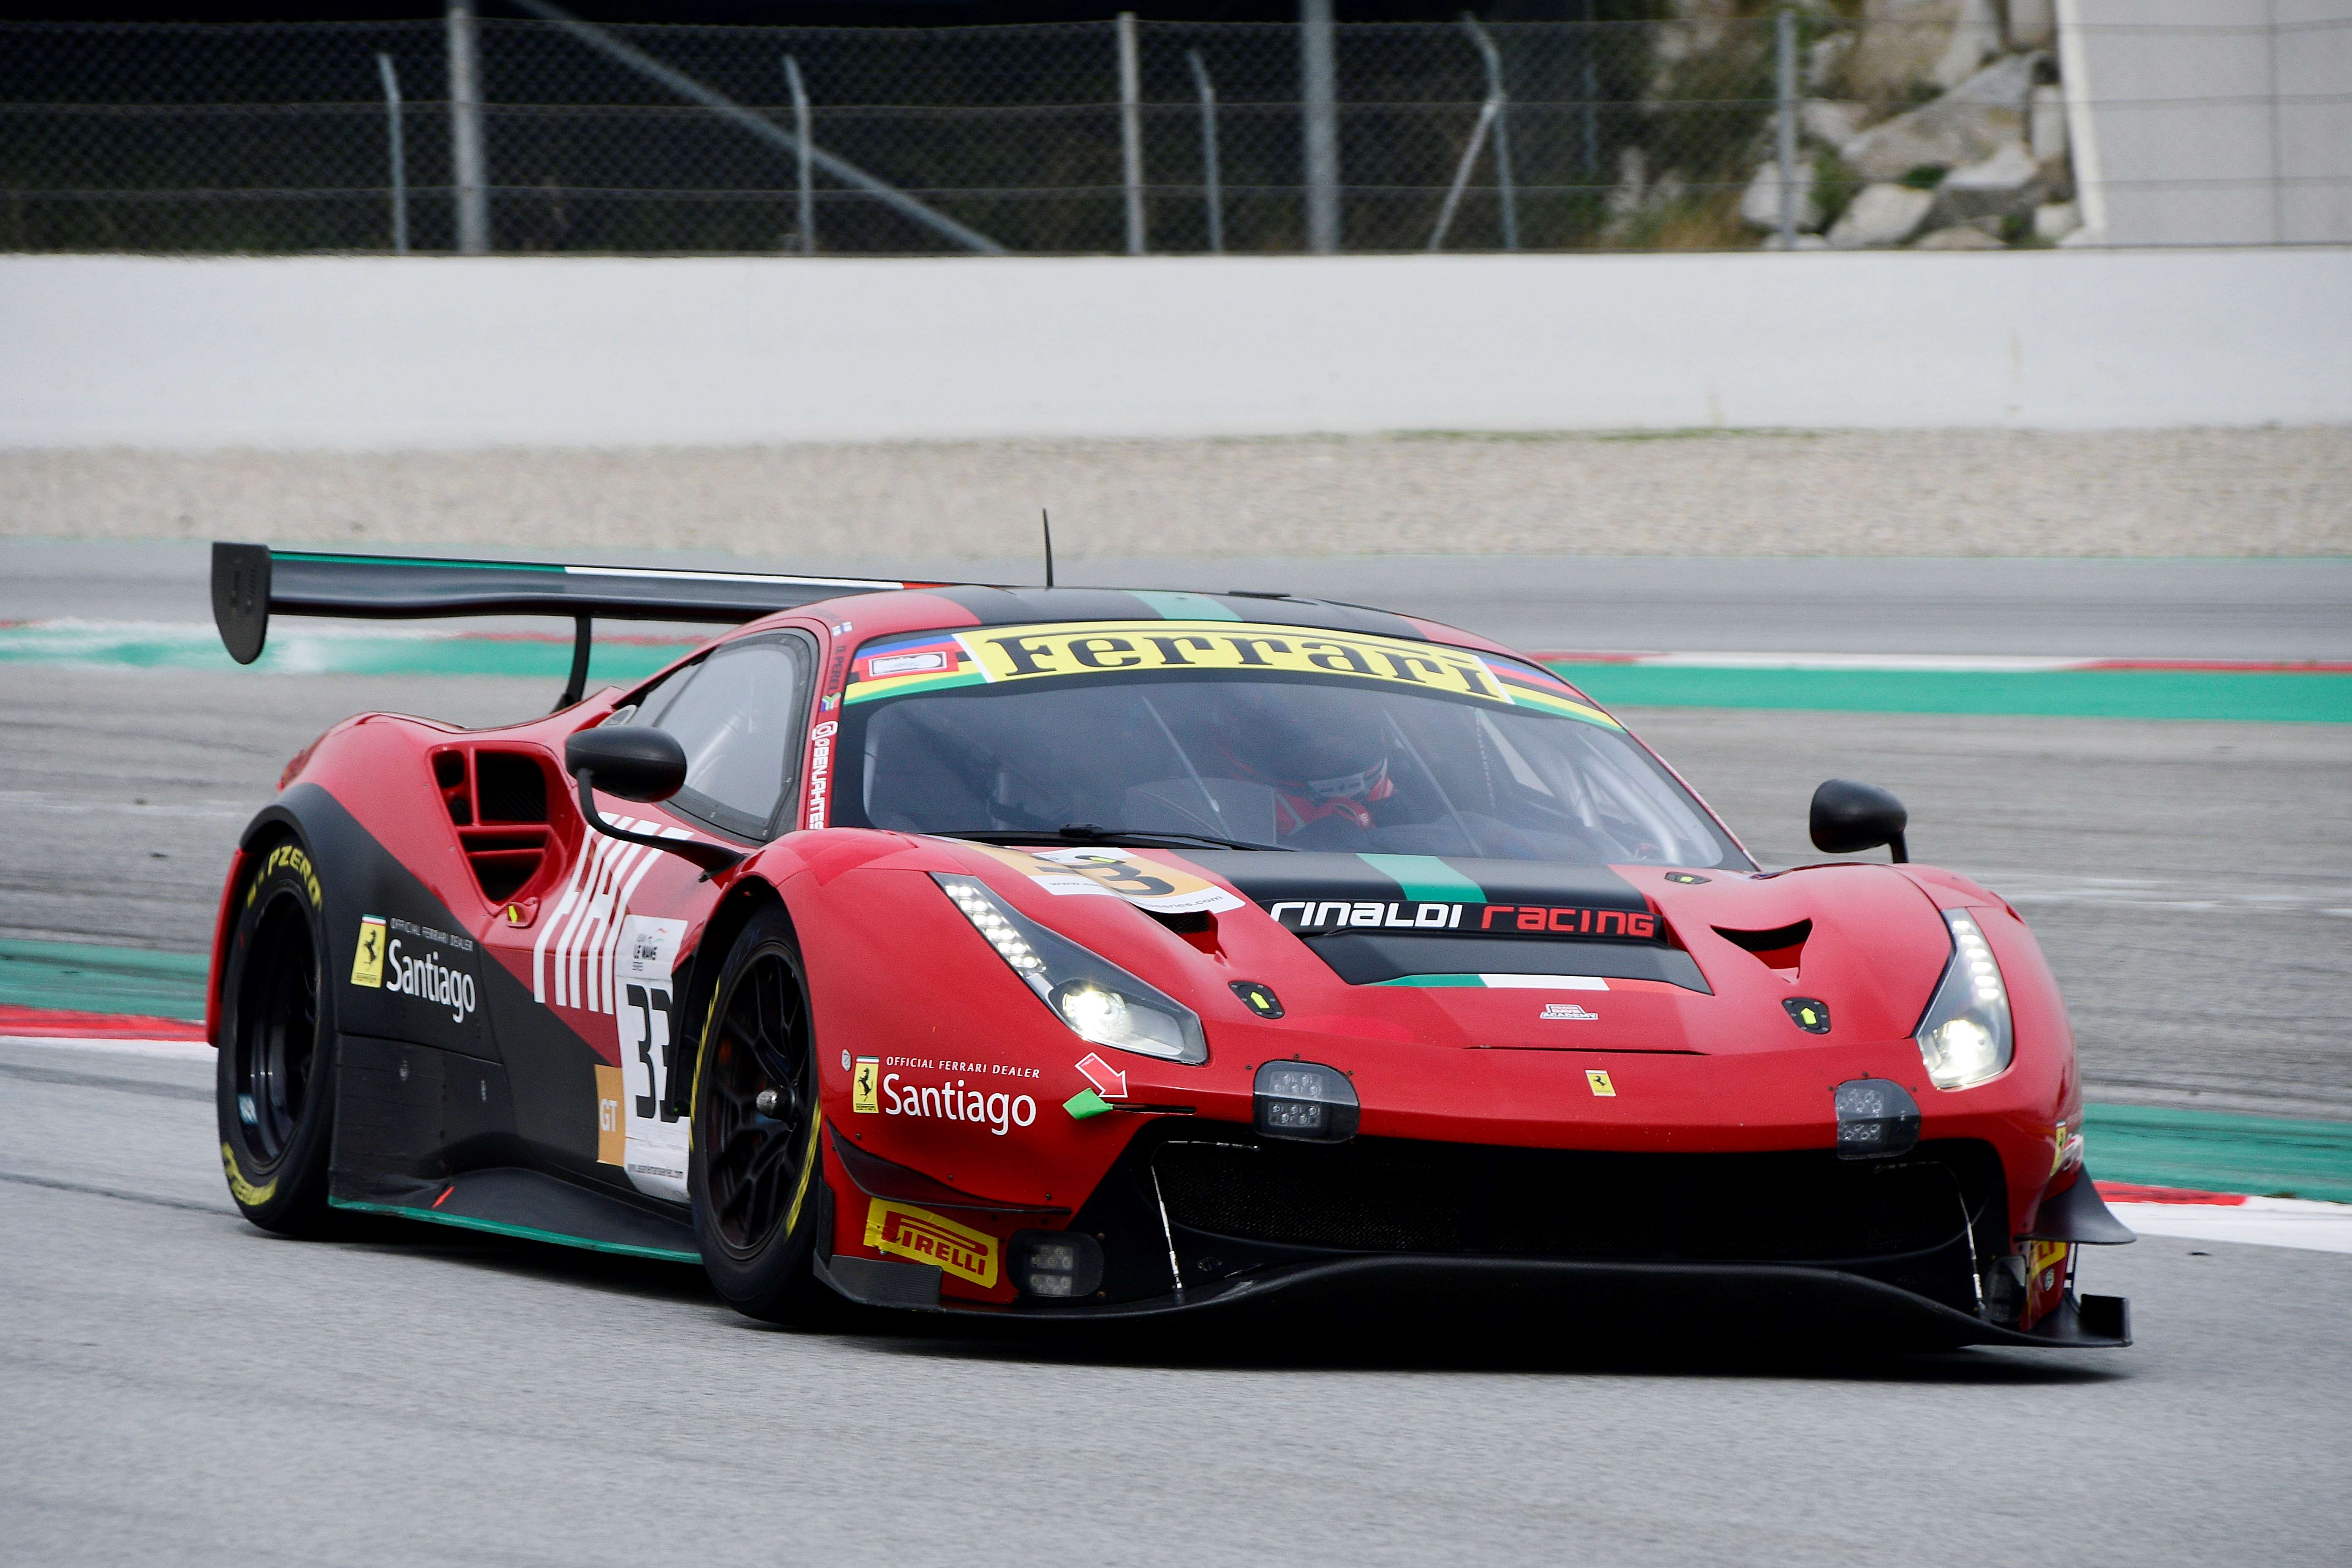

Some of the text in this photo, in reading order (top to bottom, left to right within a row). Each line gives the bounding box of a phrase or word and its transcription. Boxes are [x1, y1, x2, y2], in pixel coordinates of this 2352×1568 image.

[985, 627, 1503, 698] Ferrari
[386, 939, 476, 1024] Santiago
[886, 1056, 1040, 1078] OFFICIAL FERRARI DEALER
[599, 1099, 618, 1132] GT
[883, 1073, 1037, 1135] Santiago
[882, 1210, 989, 1276] PIRELLI
